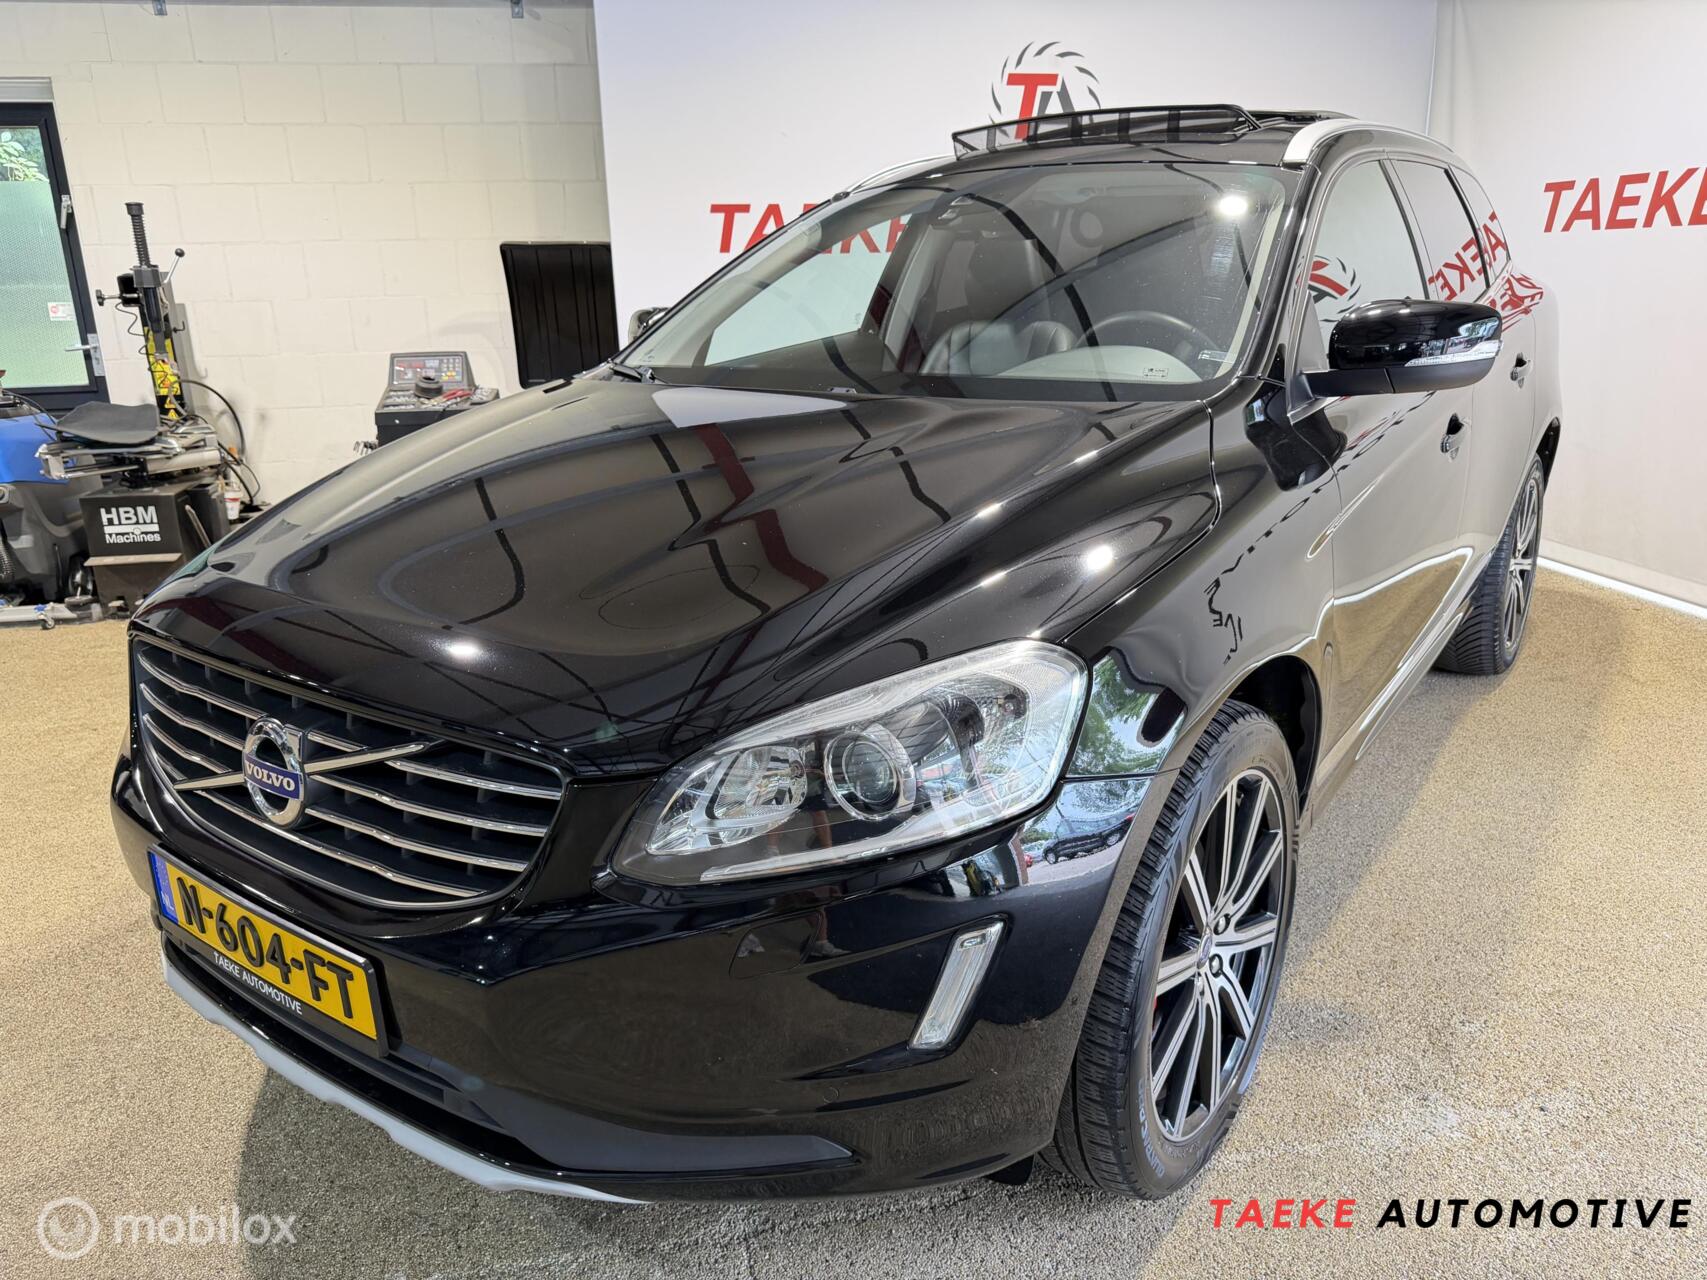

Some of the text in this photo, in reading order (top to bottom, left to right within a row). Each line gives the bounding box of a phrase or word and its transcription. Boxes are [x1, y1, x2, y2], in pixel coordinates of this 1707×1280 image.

[100, 505, 159, 526] HBM
[105, 532, 161, 544] Machines
[244, 761, 296, 791] VOLVO
[176, 876, 354, 1019] N-604-FT
[213, 951, 303, 1015] TAEKE AUTOMOTIVE
